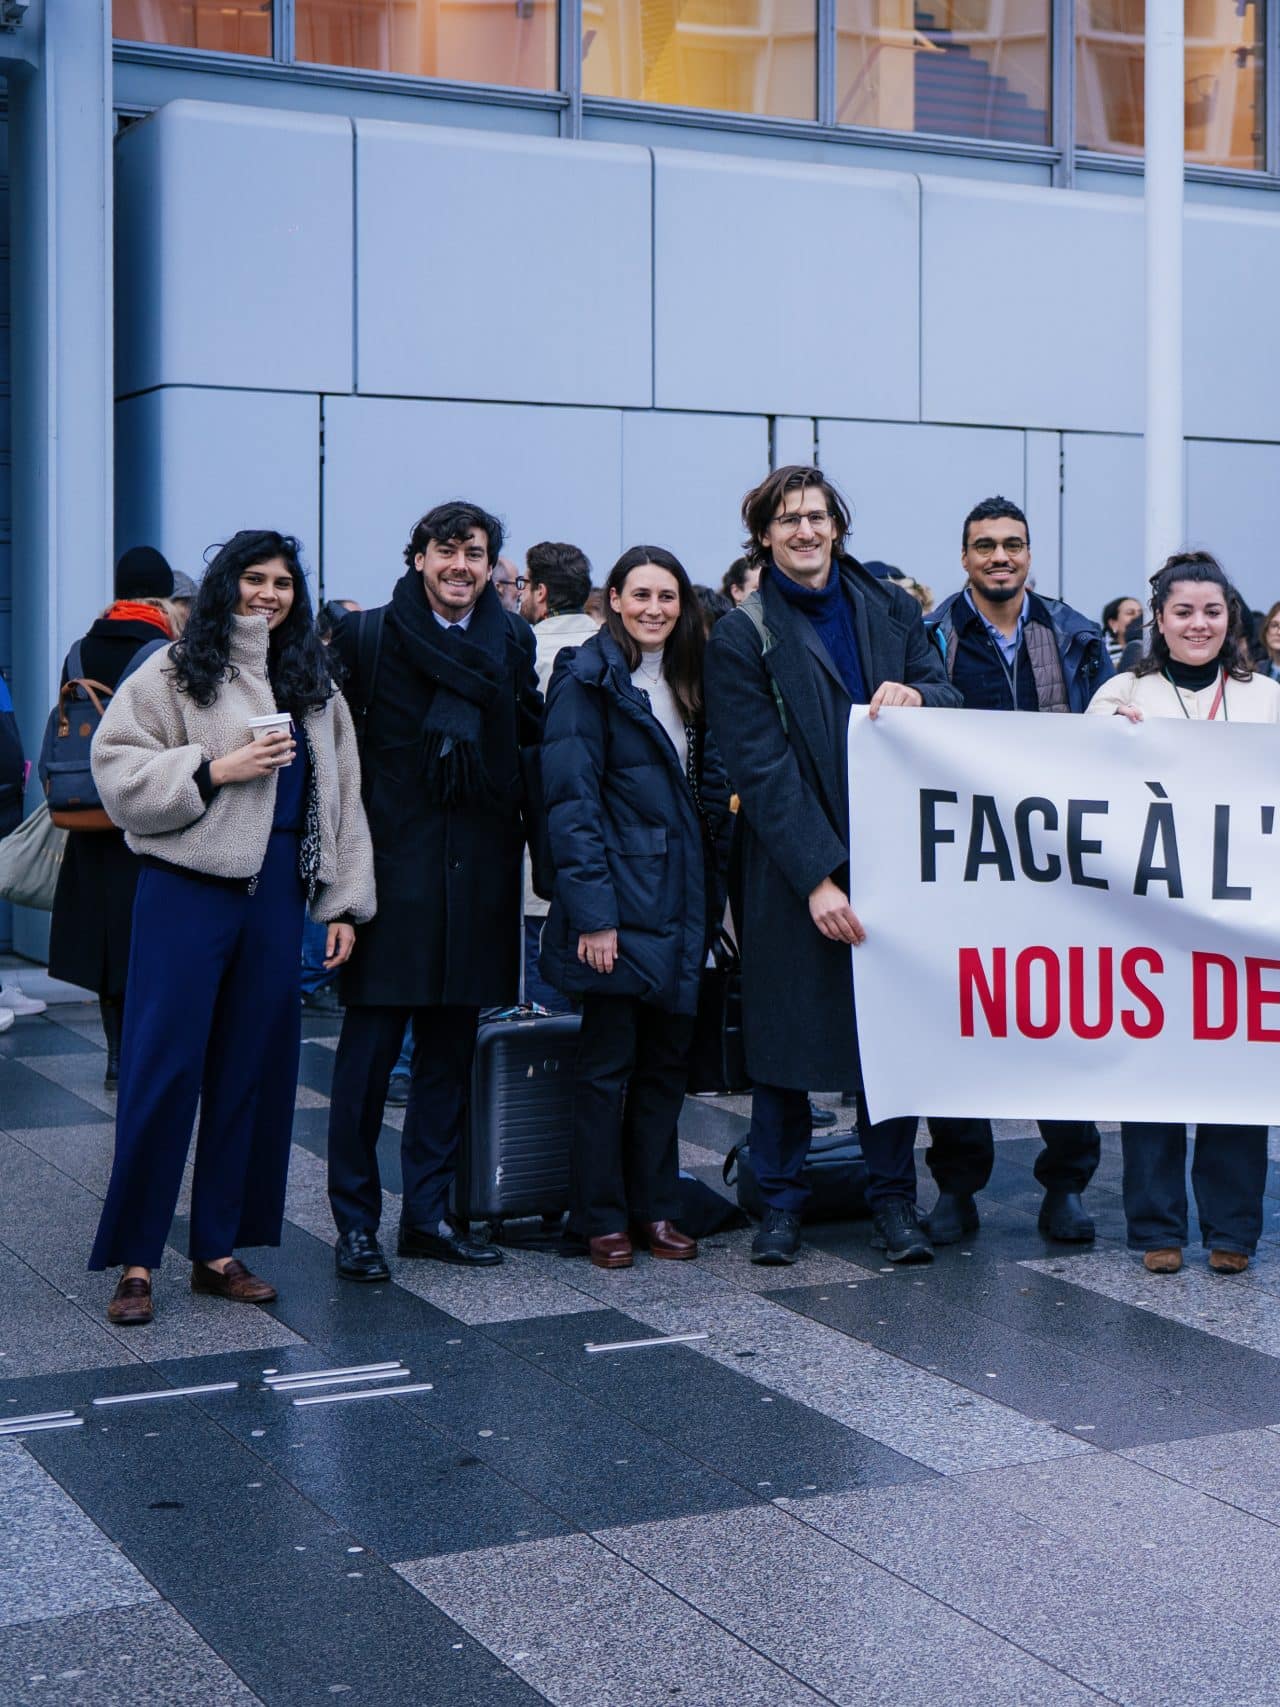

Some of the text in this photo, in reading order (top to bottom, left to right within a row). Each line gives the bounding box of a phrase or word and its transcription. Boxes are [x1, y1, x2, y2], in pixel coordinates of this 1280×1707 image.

[919, 787, 1110, 891] FACE
[1133, 781, 1184, 899] À
[958, 945, 1165, 1040] NOUS
